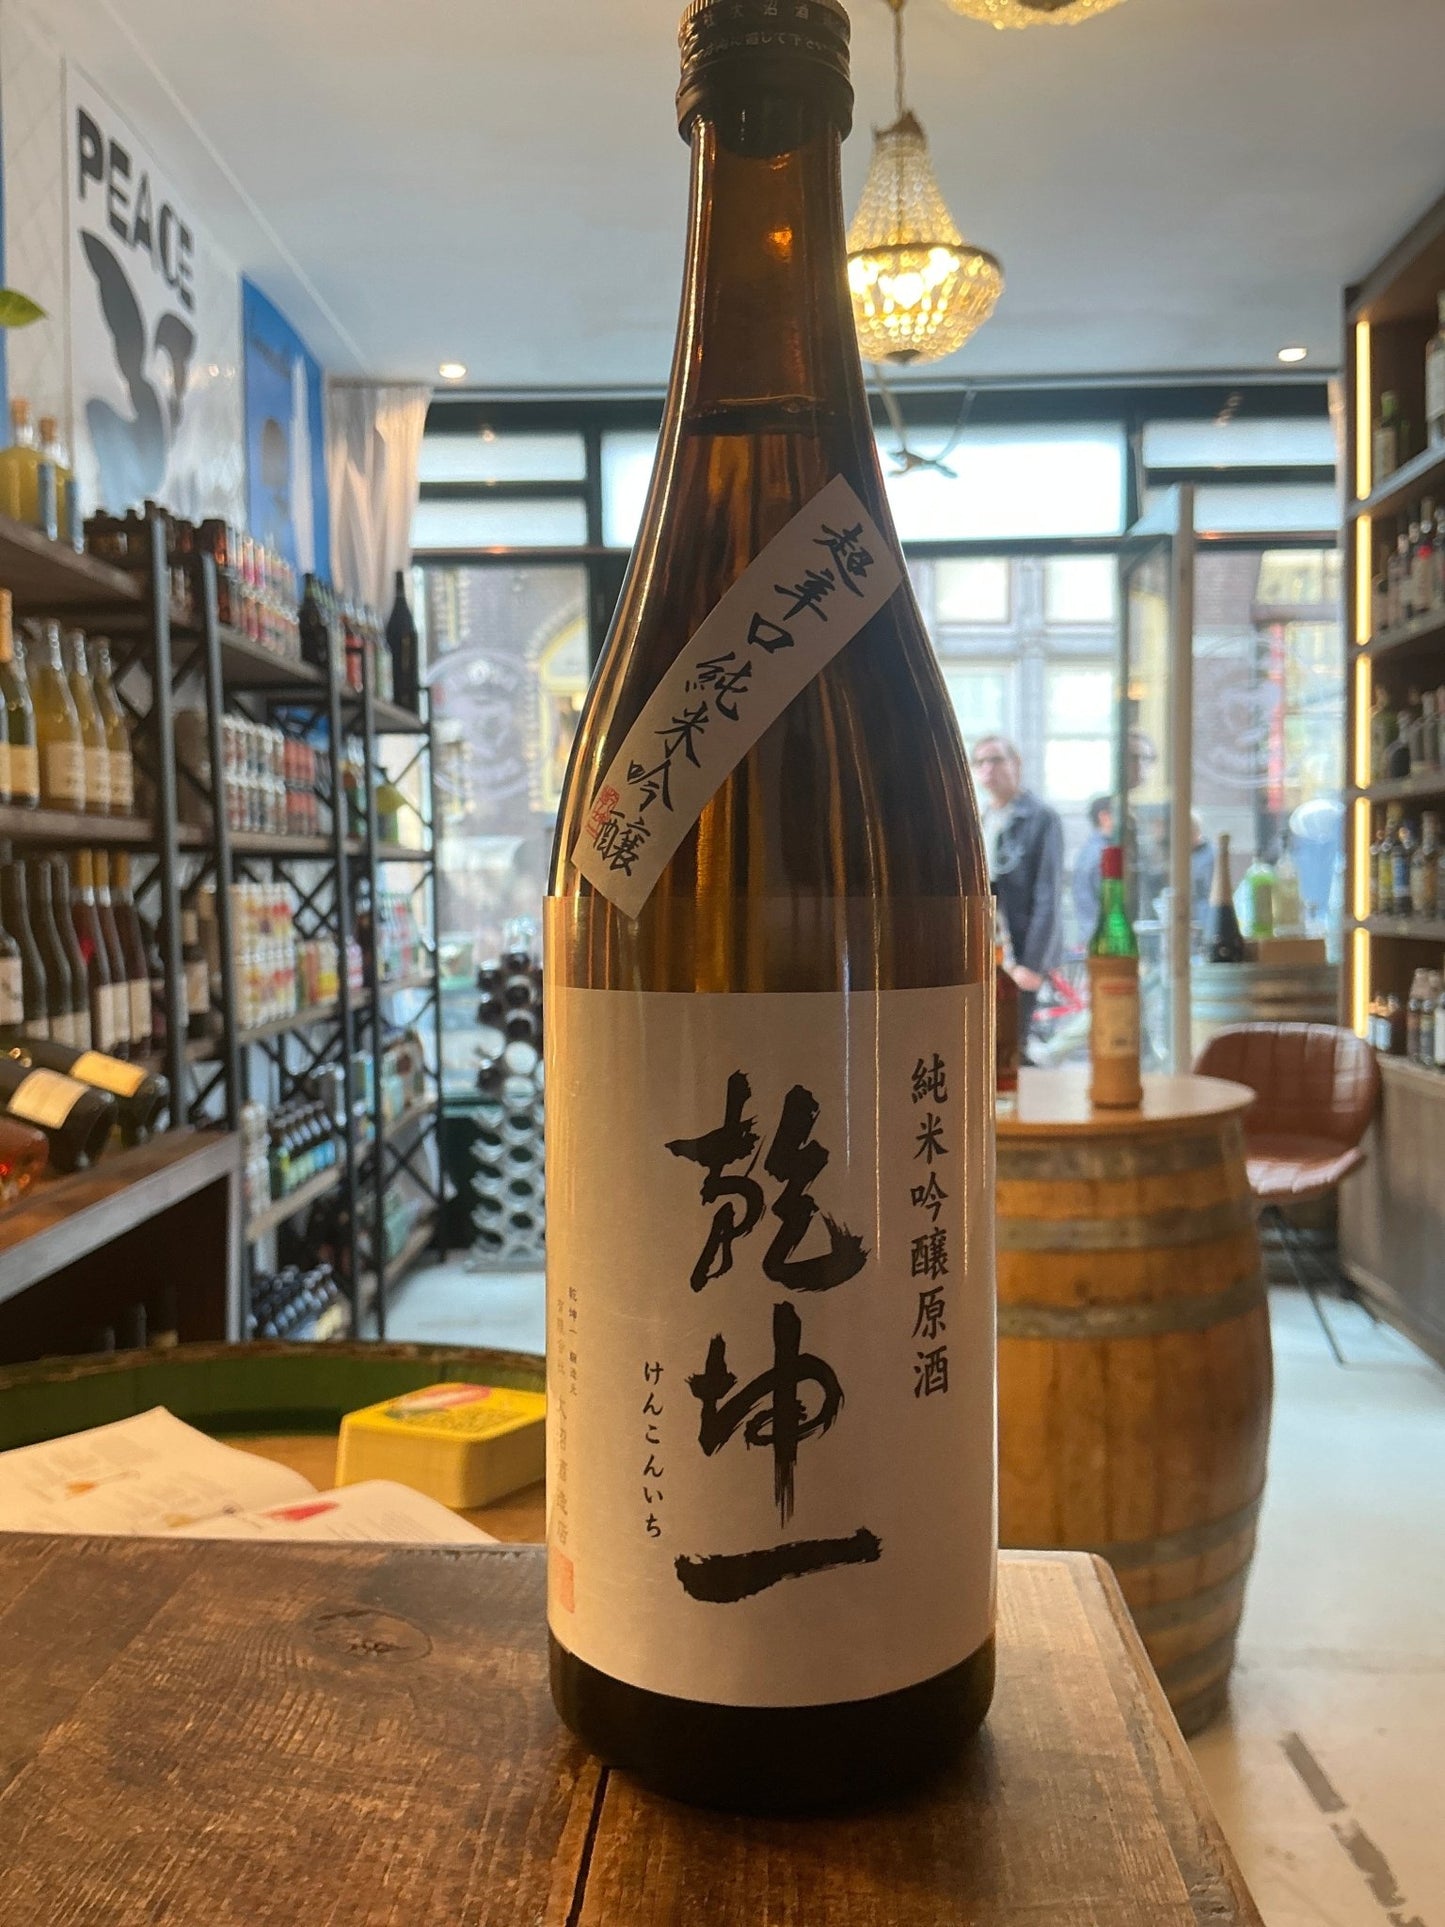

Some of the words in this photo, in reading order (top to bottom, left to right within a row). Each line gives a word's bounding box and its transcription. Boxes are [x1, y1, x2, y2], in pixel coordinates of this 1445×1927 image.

[77, 107, 194, 311] PEACE
[594, 522, 875, 877] 超辛口純米吟醸
[665, 1069, 883, 1604] 乾坤一
[911, 1053, 949, 1398] 純米吟醸原酒
[642, 1361, 665, 1538] けんこんいち
